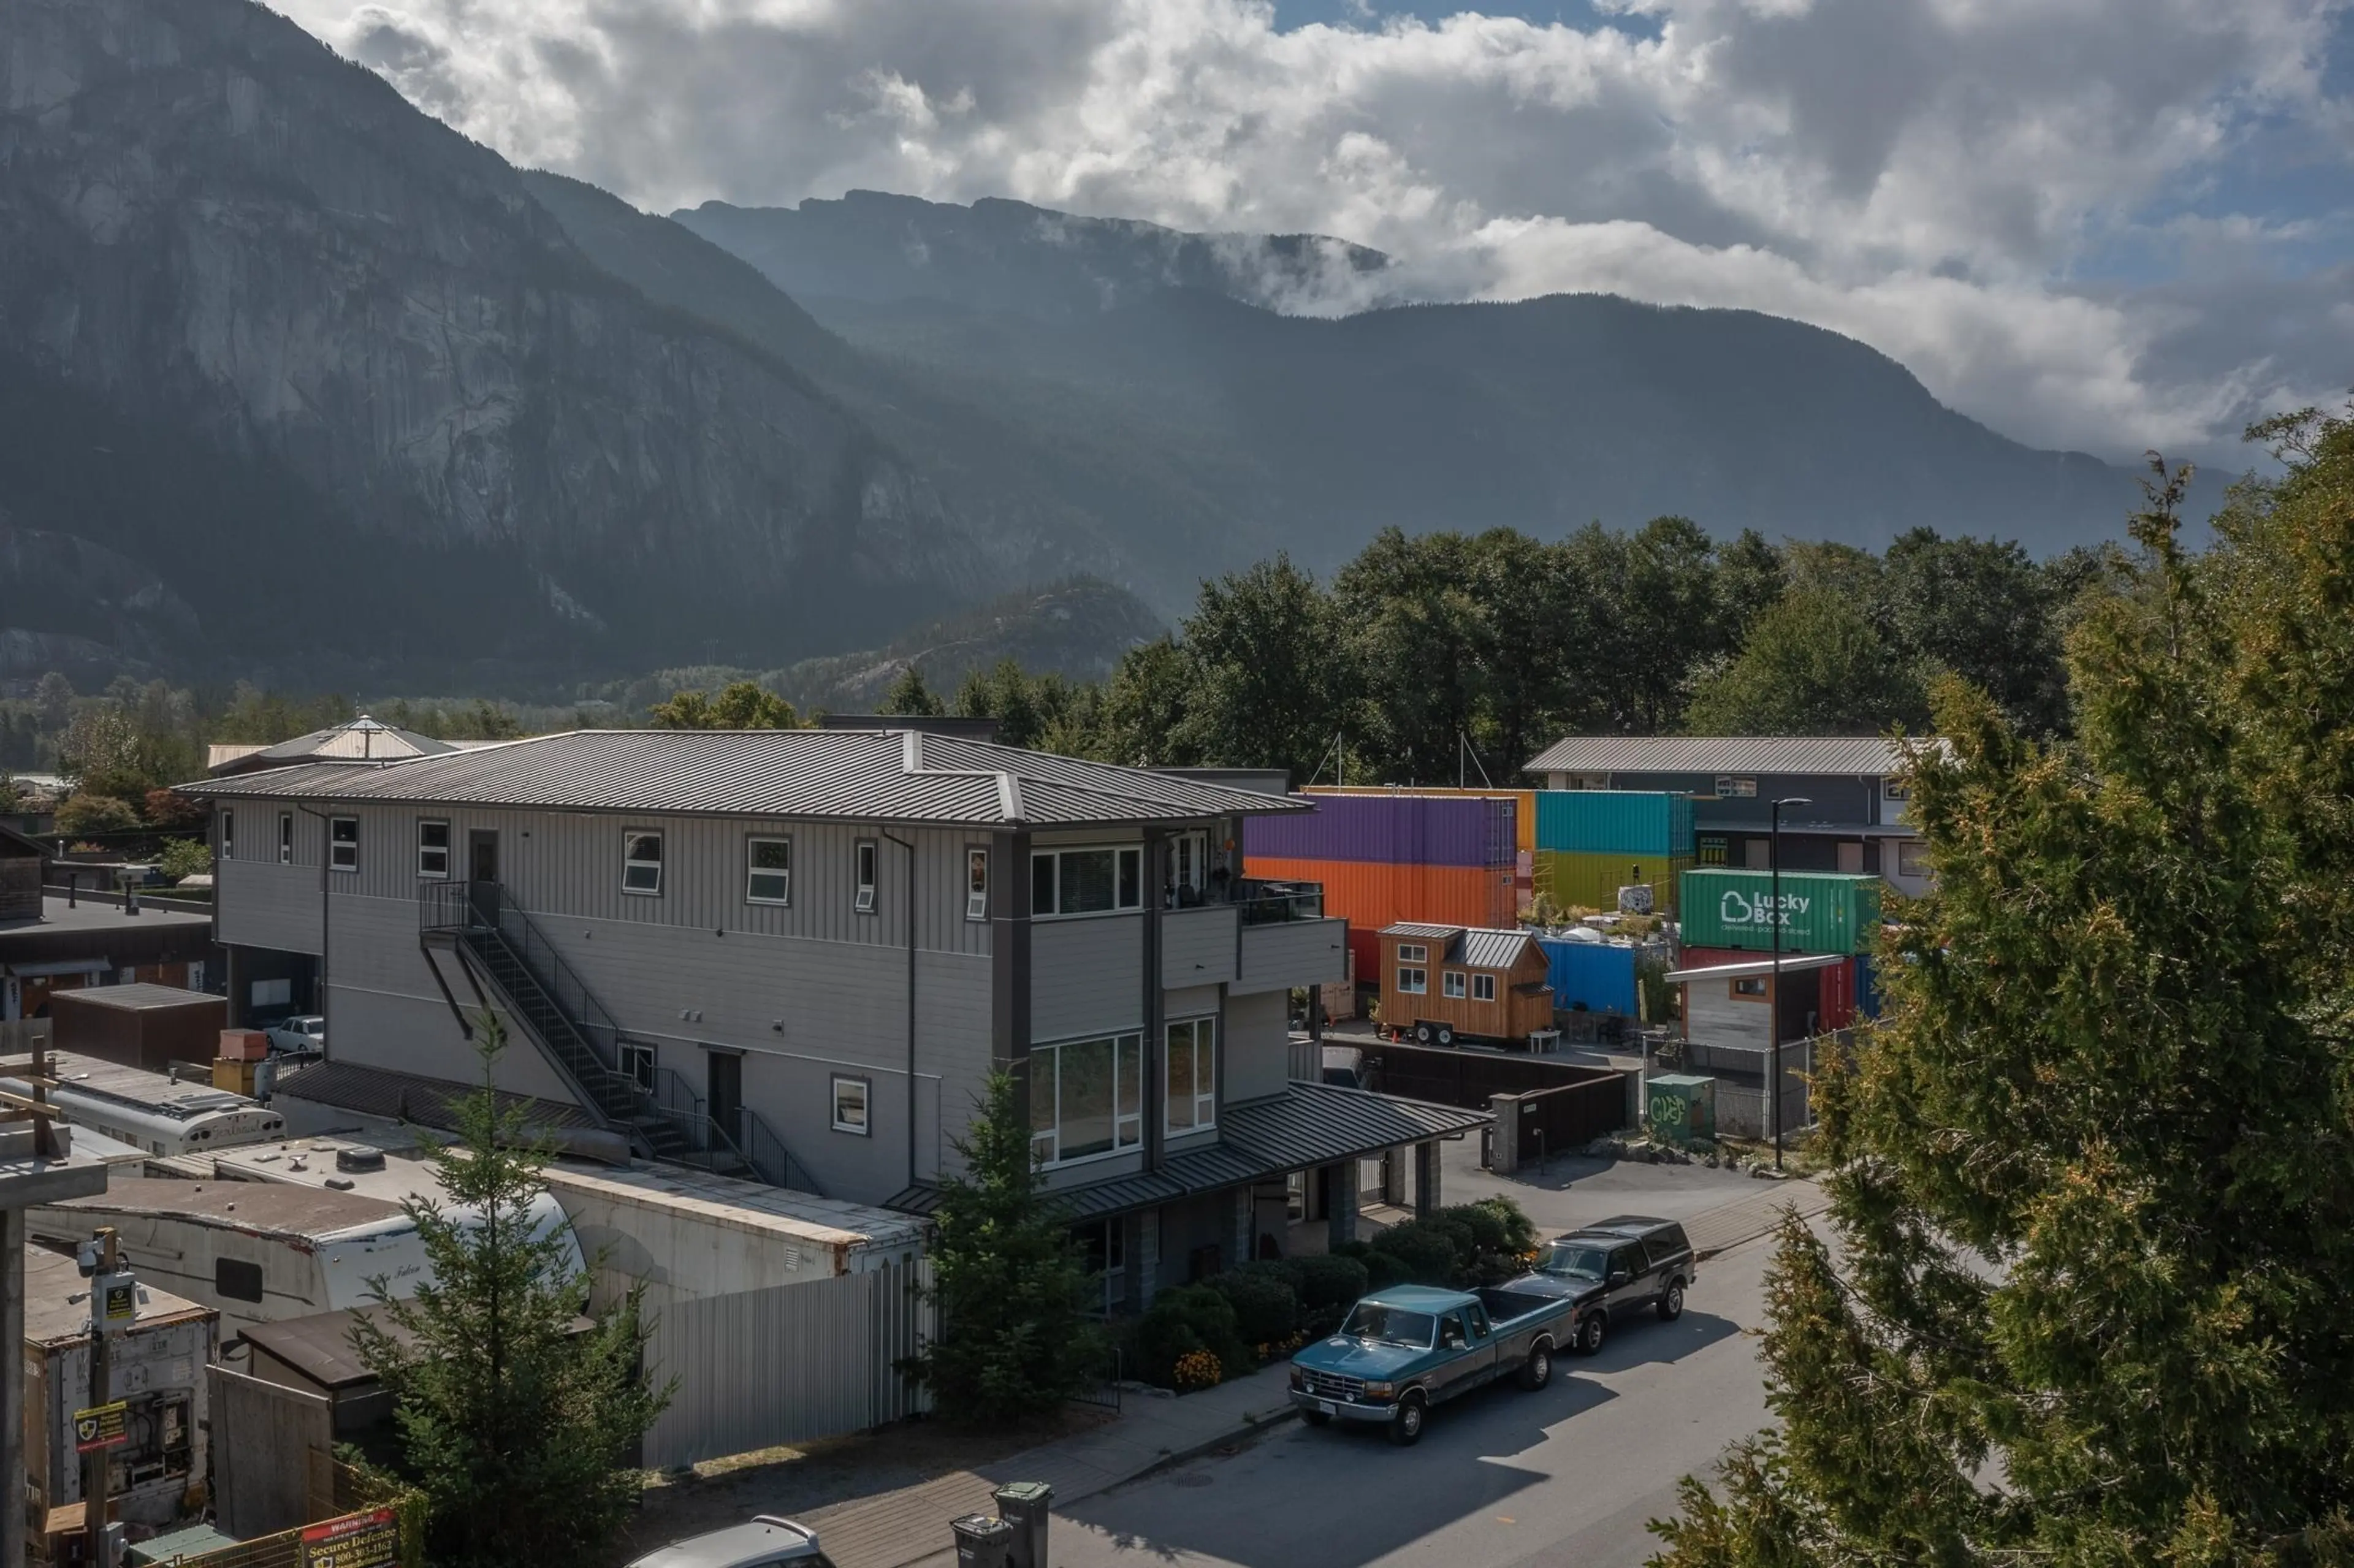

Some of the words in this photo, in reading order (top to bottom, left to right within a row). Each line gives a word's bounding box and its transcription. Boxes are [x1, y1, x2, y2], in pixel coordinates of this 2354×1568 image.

[1754, 892, 1810, 913] Lucky
[1754, 908, 1790, 925] Box
[332, 1515, 374, 1532] WARNING
[309, 1540, 349, 1559] Secure
[352, 1528, 397, 1547] Defence
